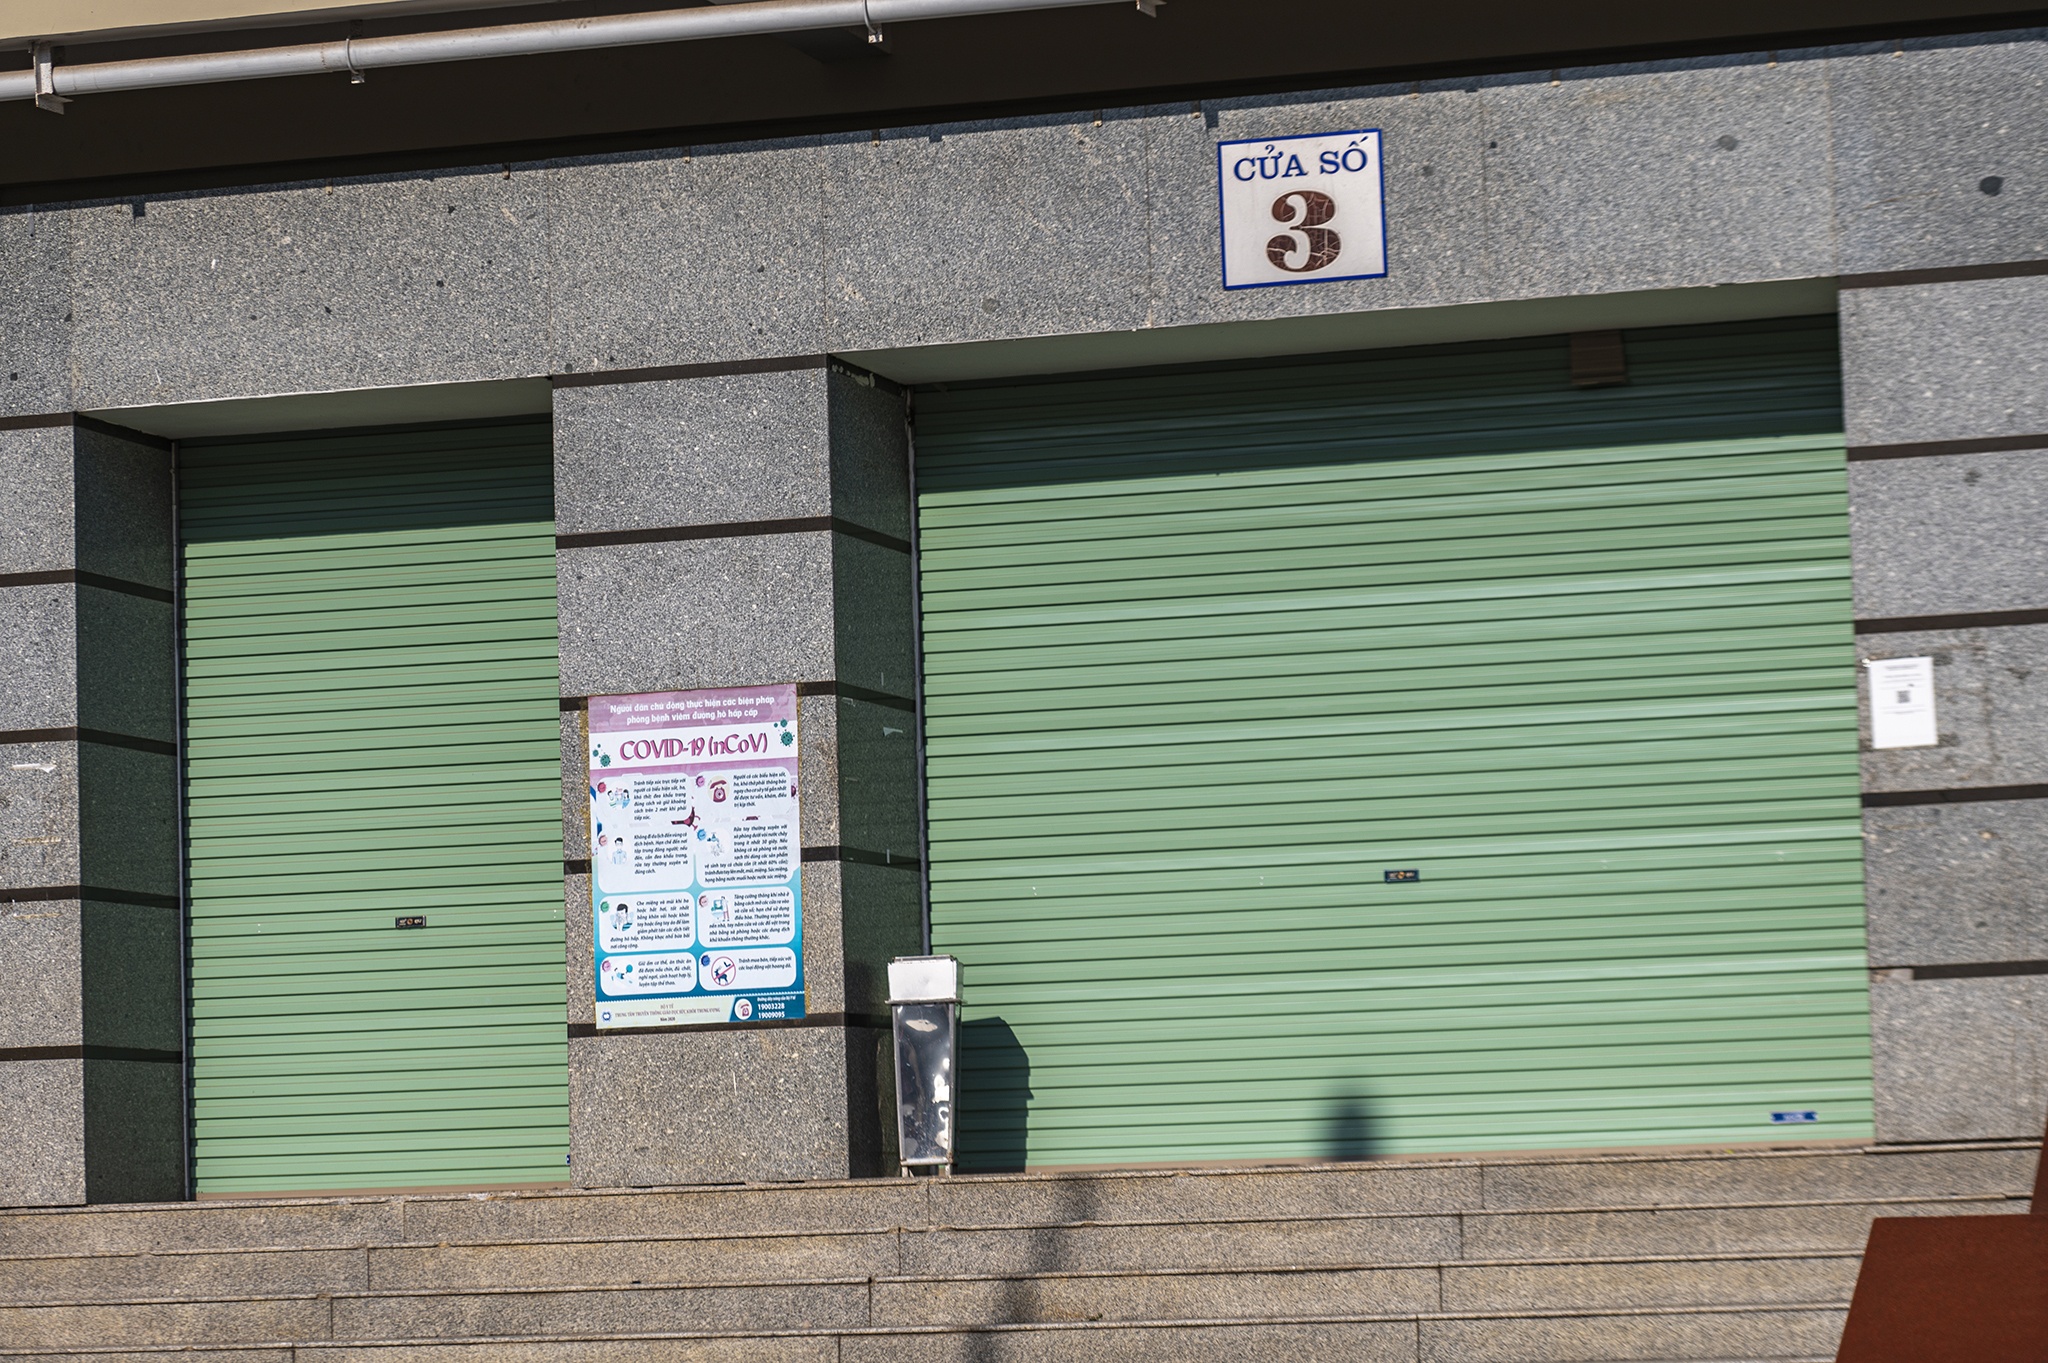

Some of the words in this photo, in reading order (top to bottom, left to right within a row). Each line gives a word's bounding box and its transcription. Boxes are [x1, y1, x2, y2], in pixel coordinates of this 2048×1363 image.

[1234, 144, 1308, 181] CỬA
[1320, 136, 1369, 175] SỐ
[1266, 190, 1341, 272] 3
[620, 736, 705, 761] COVID-19
[708, 732, 768, 757] (nCoV)
